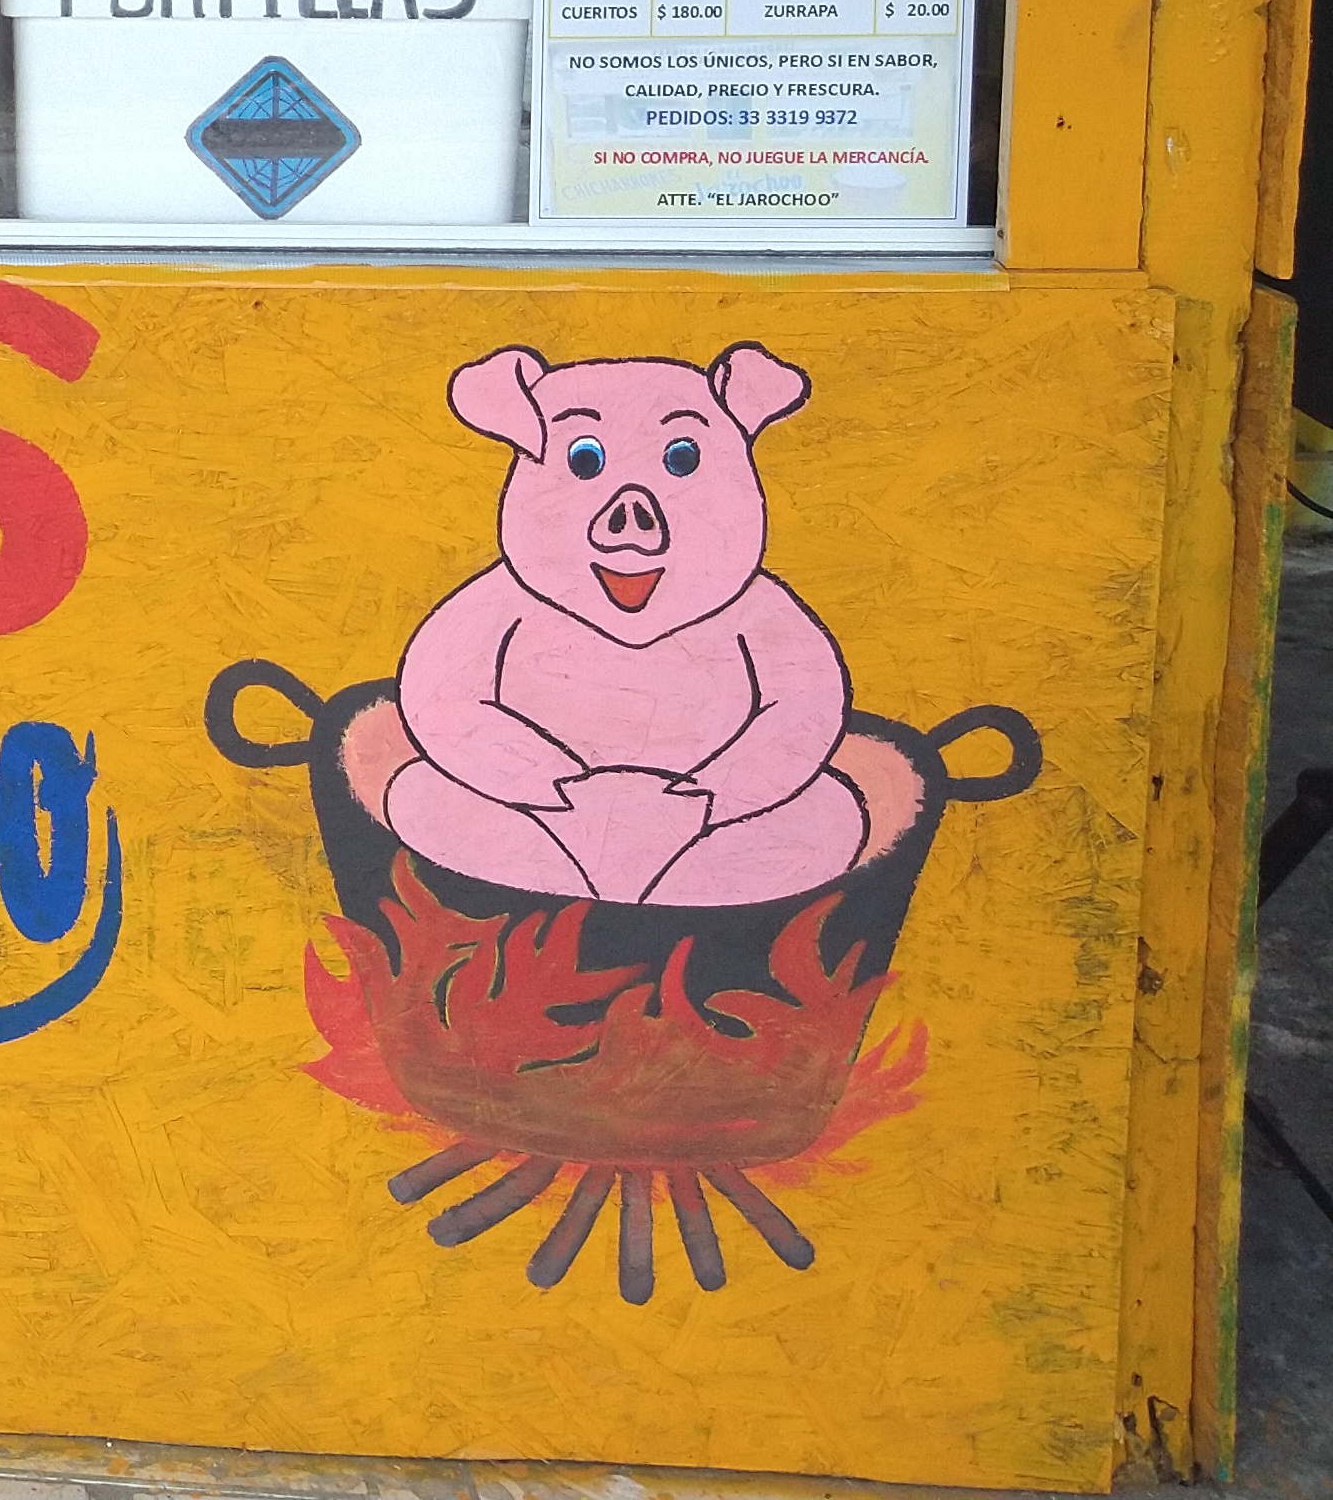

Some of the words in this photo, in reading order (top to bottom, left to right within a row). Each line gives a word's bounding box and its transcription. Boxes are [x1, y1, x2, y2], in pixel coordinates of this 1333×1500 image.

[562, 6, 637, 20] CUERITOS
[764, 5, 838, 18] ZURRAPA
[907, 3, 949, 17] 20.00
[569, 56, 595, 69] NO
[599, 55, 663, 69] SOMOS
[667, 55, 699, 68] LOS
[703, 50, 773, 71] ÚNICOS,
[779, 54, 822, 68] PERO
[828, 54, 842, 68] SI
[847, 54, 870, 67] EN
[874, 54, 937, 70] SABOR,
[625, 83, 703, 100] CALIDAD,
[708, 83, 768, 97] PRECIO
[773, 83, 784, 96] Y
[789, 83, 879, 97] FRESCURA.
[646, 111, 733, 126] PEDIDOS:
[738, 110, 760, 126] 33
[766, 110, 809, 125] 3319
[815, 110, 857, 125] 9372
[594, 151, 607, 164] SI
[612, 151, 636, 164] NO
[641, 150, 712, 167] COMPRA,
[718, 151, 741, 164] NO
[746, 150, 804, 164] JUEGUE
[809, 150, 828, 164] LA
[832, 146, 929, 164] MERCANCÍA.
[657, 193, 702, 207] ATTE.
